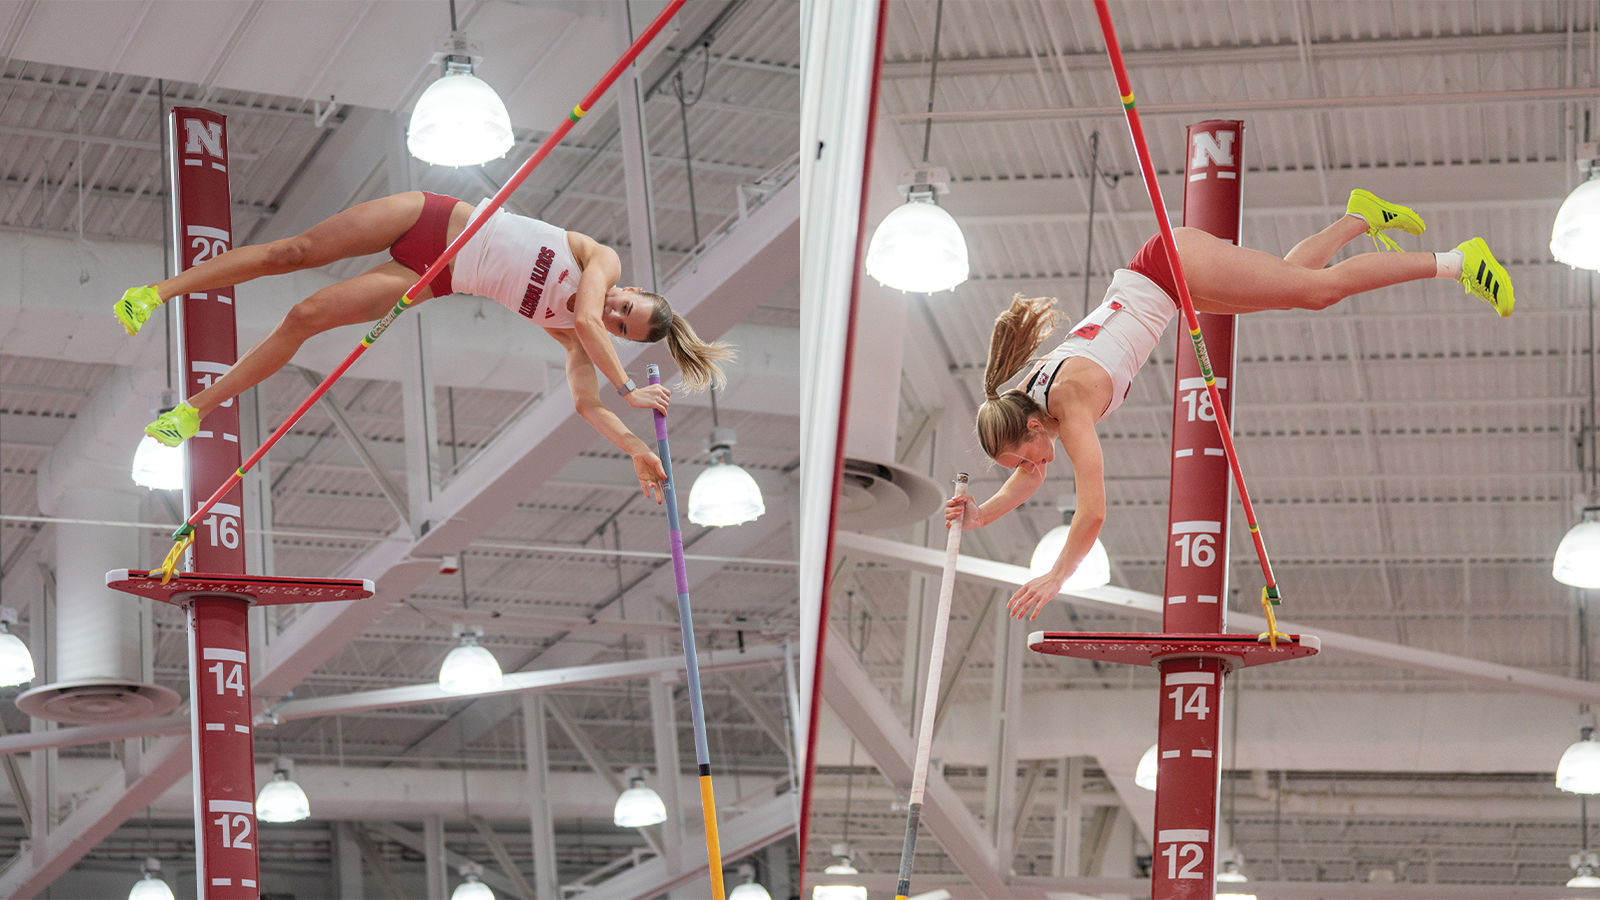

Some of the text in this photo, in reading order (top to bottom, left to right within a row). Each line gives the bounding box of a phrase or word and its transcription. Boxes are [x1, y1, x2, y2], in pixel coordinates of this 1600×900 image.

[185, 118, 223, 159] N
[1191, 130, 1235, 169] N
[530, 246, 556, 286] SOUTH
[197, 374, 234, 407] 1
[1182, 390, 1220, 422] 18
[203, 515, 239, 549] 16
[1174, 534, 1216, 568] 16
[209, 662, 245, 697] 14
[1168, 686, 1210, 721] 14
[215, 814, 252, 850] 12
[1162, 843, 1204, 879] 12
